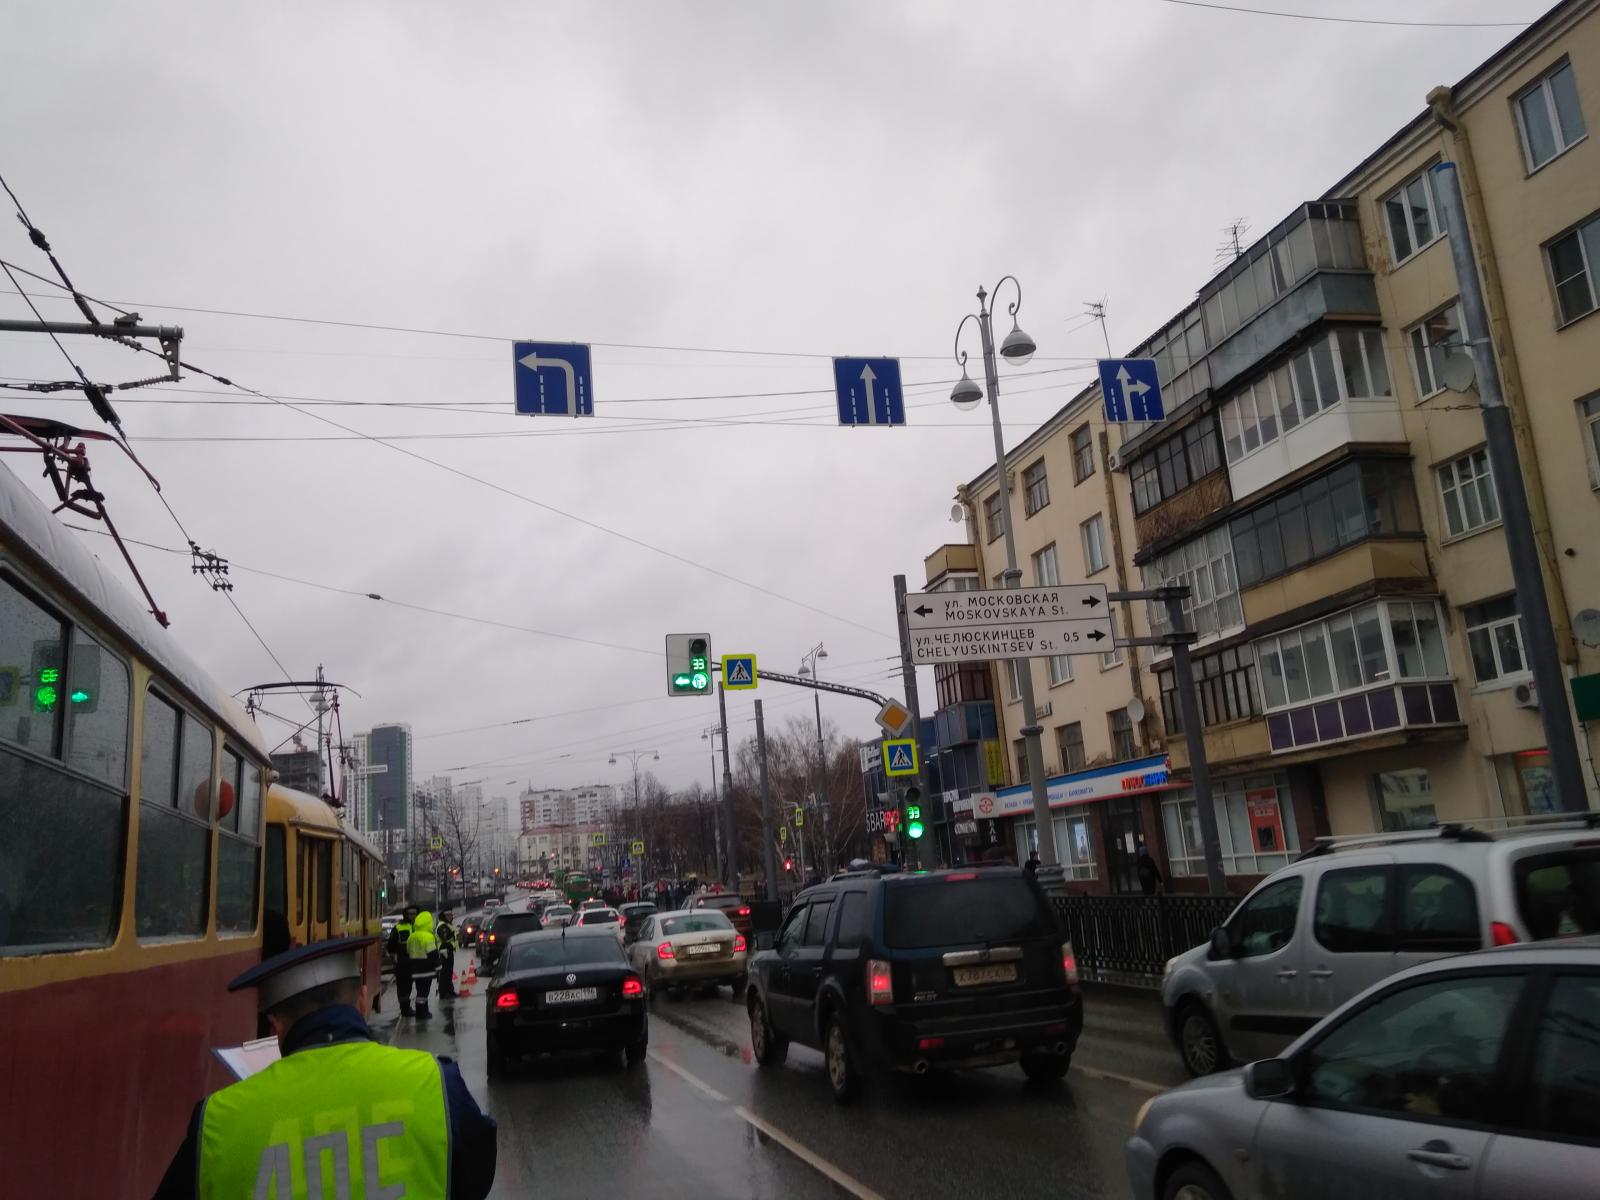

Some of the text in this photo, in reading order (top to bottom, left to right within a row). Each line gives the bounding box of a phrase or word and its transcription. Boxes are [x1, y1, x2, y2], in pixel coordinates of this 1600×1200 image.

[945, 592, 1059, 611] ул. МОСКОВСКАЯ
[945, 606, 1046, 622] MOSKOVSKAYA
[917, 641, 1034, 658] CHELYUSKINTSEV
